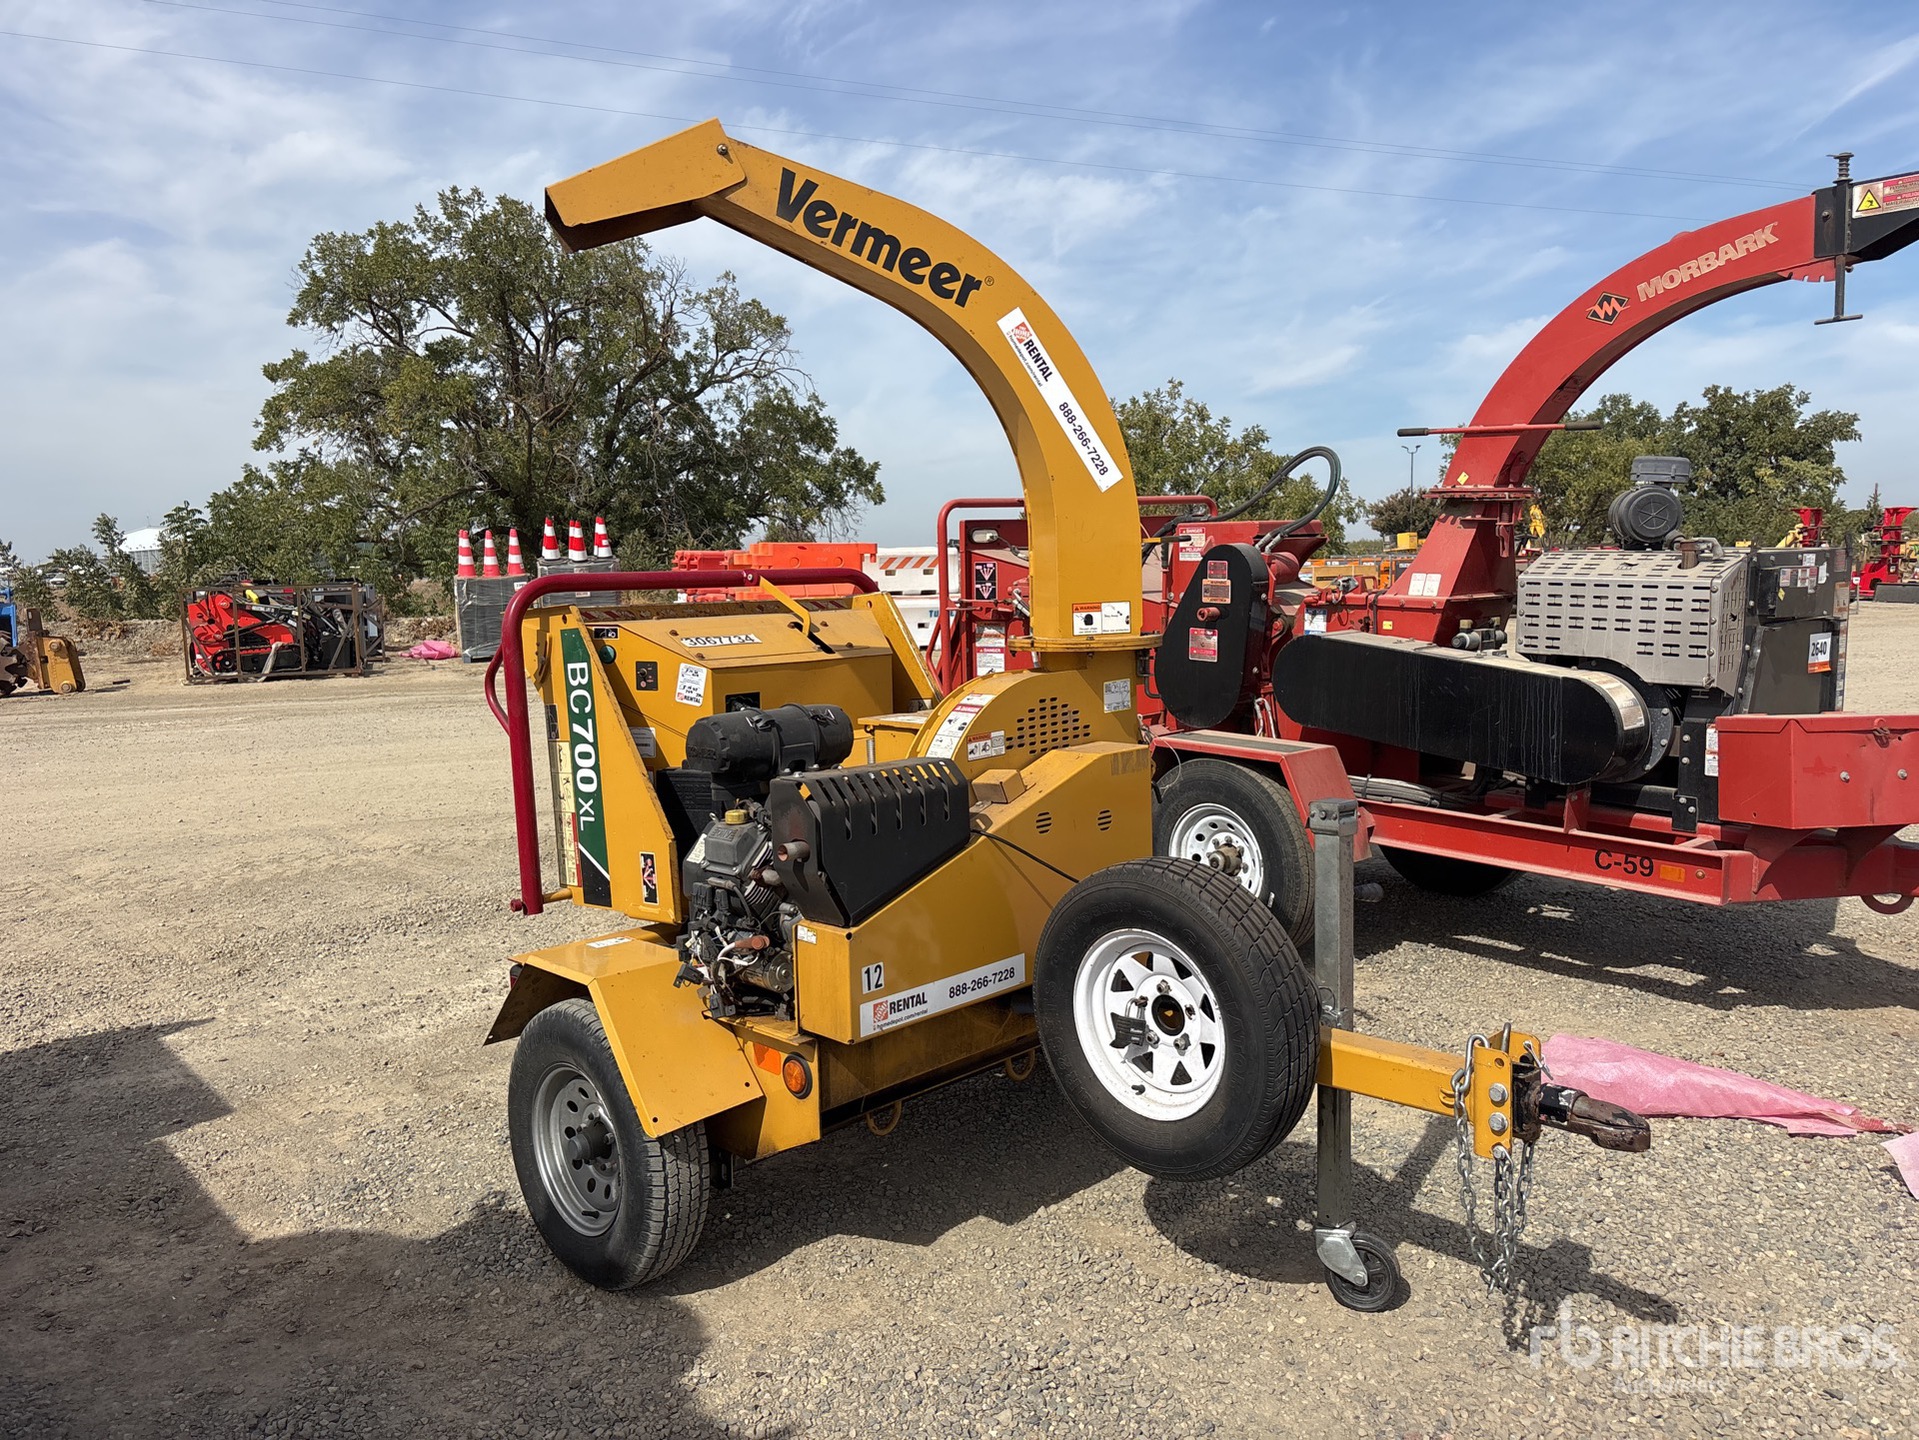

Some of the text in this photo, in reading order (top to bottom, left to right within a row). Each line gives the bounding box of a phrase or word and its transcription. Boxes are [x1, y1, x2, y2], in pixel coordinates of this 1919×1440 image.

[776, 167, 983, 308] Vermeer
[1636, 222, 1779, 302] MORBARK
[1023, 339, 1054, 382] RENTAL
[1059, 402, 1109, 476] 888-266-7228
[684, 634, 755, 646] 3067734
[1811, 641, 1828, 657] 2640
[1594, 850, 1655, 878] C-59
[864, 964, 883, 991] 12
[949, 967, 1015, 999] 888-266-7228
[889, 992, 928, 1015] RENTAL
